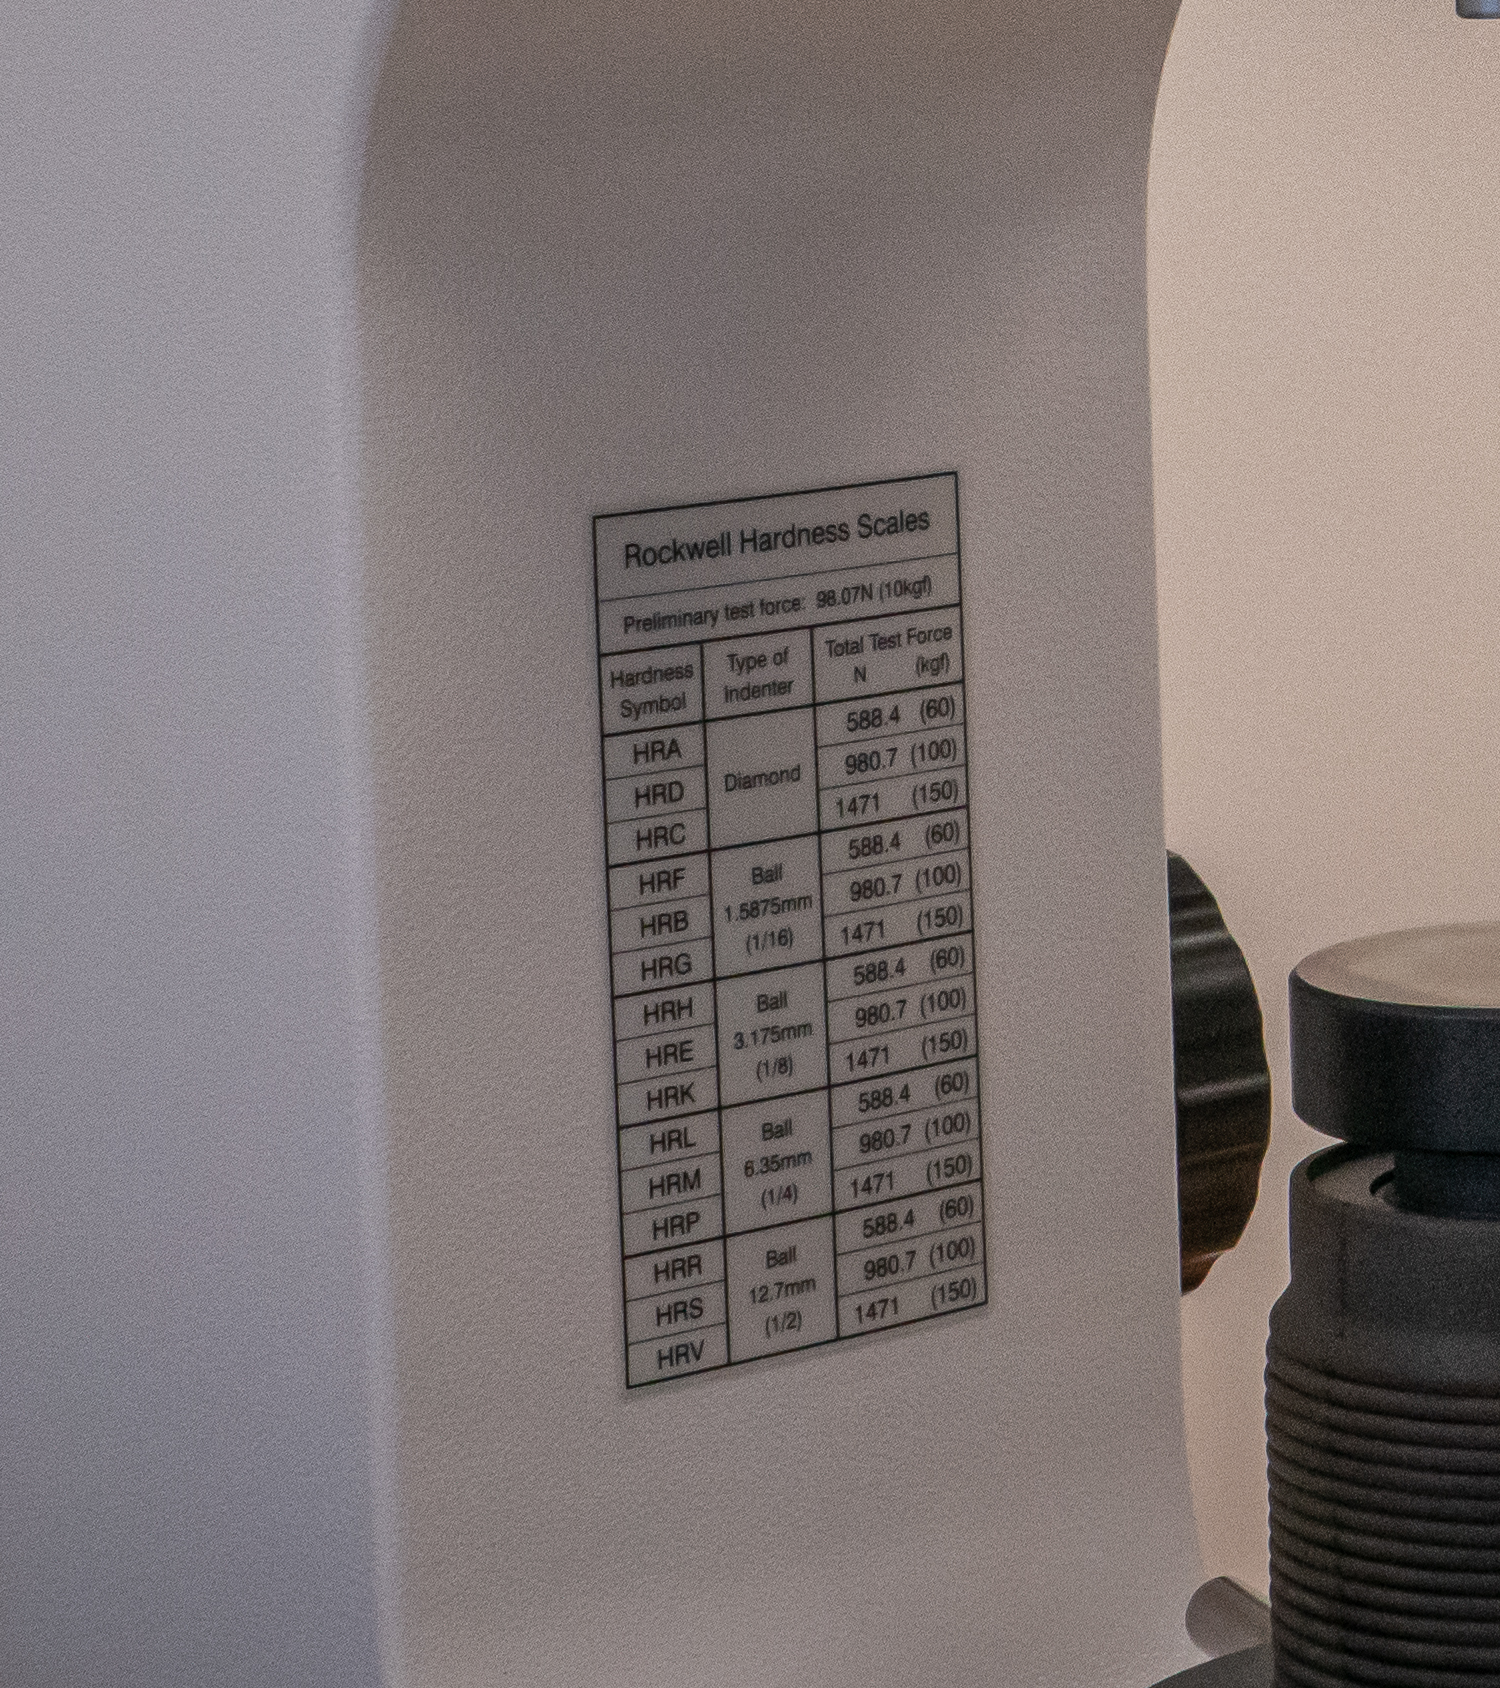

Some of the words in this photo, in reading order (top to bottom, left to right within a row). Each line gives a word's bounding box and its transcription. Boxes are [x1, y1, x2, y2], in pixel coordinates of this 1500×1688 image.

[625, 531, 731, 568] Rockwell
[740, 519, 850, 554] Hardness
[858, 510, 930, 539] Scales
[623, 607, 720, 634] Preliminary
[725, 600, 755, 621] test
[816, 583, 873, 608] 98.07N
[825, 637, 864, 659] Total
[870, 632, 901, 651] Test
[907, 625, 953, 645] Force
[726, 652, 767, 674] Type
[773, 647, 789, 666] of
[854, 666, 866, 682] N
[915, 652, 950, 677] (kgf)
[610, 662, 693, 688] Hardness
[724, 680, 794, 703] Indenter
[620, 693, 687, 719] Symbol
[847, 705, 900, 732] 588.4
[920, 697, 955, 725] (60)
[633, 738, 682, 764] HRA
[845, 748, 898, 775] 980.7
[911, 739, 957, 767] (100)
[724, 765, 800, 792] Diamond
[635, 781, 684, 807] HRD
[835, 793, 879, 818] 1471
[912, 780, 958, 809] (150)
[636, 823, 686, 849] HRC
[849, 832, 901, 859] 588.4
[925, 820, 960, 848] (60)
[639, 868, 686, 894] HRF
[751, 863, 783, 885] Ball
[850, 875, 902, 901] 980.7
[915, 864, 961, 893] (100)
[641, 911, 688, 937] HRB
[841, 920, 886, 945] 1471
[917, 905, 963, 934] (150)
[642, 953, 692, 981] HRG
[853, 957, 906, 985] 588.4
[930, 946, 964, 974] (60)
[643, 998, 693, 1024] HRH
[757, 991, 787, 1012] Ball
[855, 1000, 907, 1027] 980.7
[920, 991, 966, 1019] (100)
[734, 1022, 813, 1050] 3.175mm
[646, 1040, 693, 1067] HRE
[846, 1047, 890, 1071] 1471
[922, 1032, 968, 1061] (150)
[756, 1056, 793, 1083] (1/8)
[647, 1083, 695, 1110] HRK
[858, 1084, 910, 1112] 588.4
[934, 1072, 969, 1100] (60)
[650, 1127, 696, 1154] HRL
[762, 1119, 793, 1141] Ball
[860, 1125, 911, 1153] 980.7
[924, 1114, 970, 1142] (100)
[649, 1169, 700, 1198] HRM
[851, 1171, 894, 1198] 1471
[927, 1155, 973, 1185] (150)
[761, 1184, 798, 1210] (1/4)
[652, 1213, 700, 1240] HRP
[863, 1210, 915, 1239] 588.4
[939, 1195, 974, 1224] (60)
[654, 1255, 701, 1283] HRR
[766, 1246, 796, 1269] Ball
[864, 1252, 916, 1280] 980.7
[930, 1239, 975, 1267] (100)
[750, 1278, 816, 1304] 12.7mm
[855, 1299, 899, 1324] 1471
[931, 1280, 977, 1309] (150)
[655, 1299, 703, 1326] HRS
[765, 1313, 801, 1339] (1/2)
[657, 1343, 705, 1370] HRV
